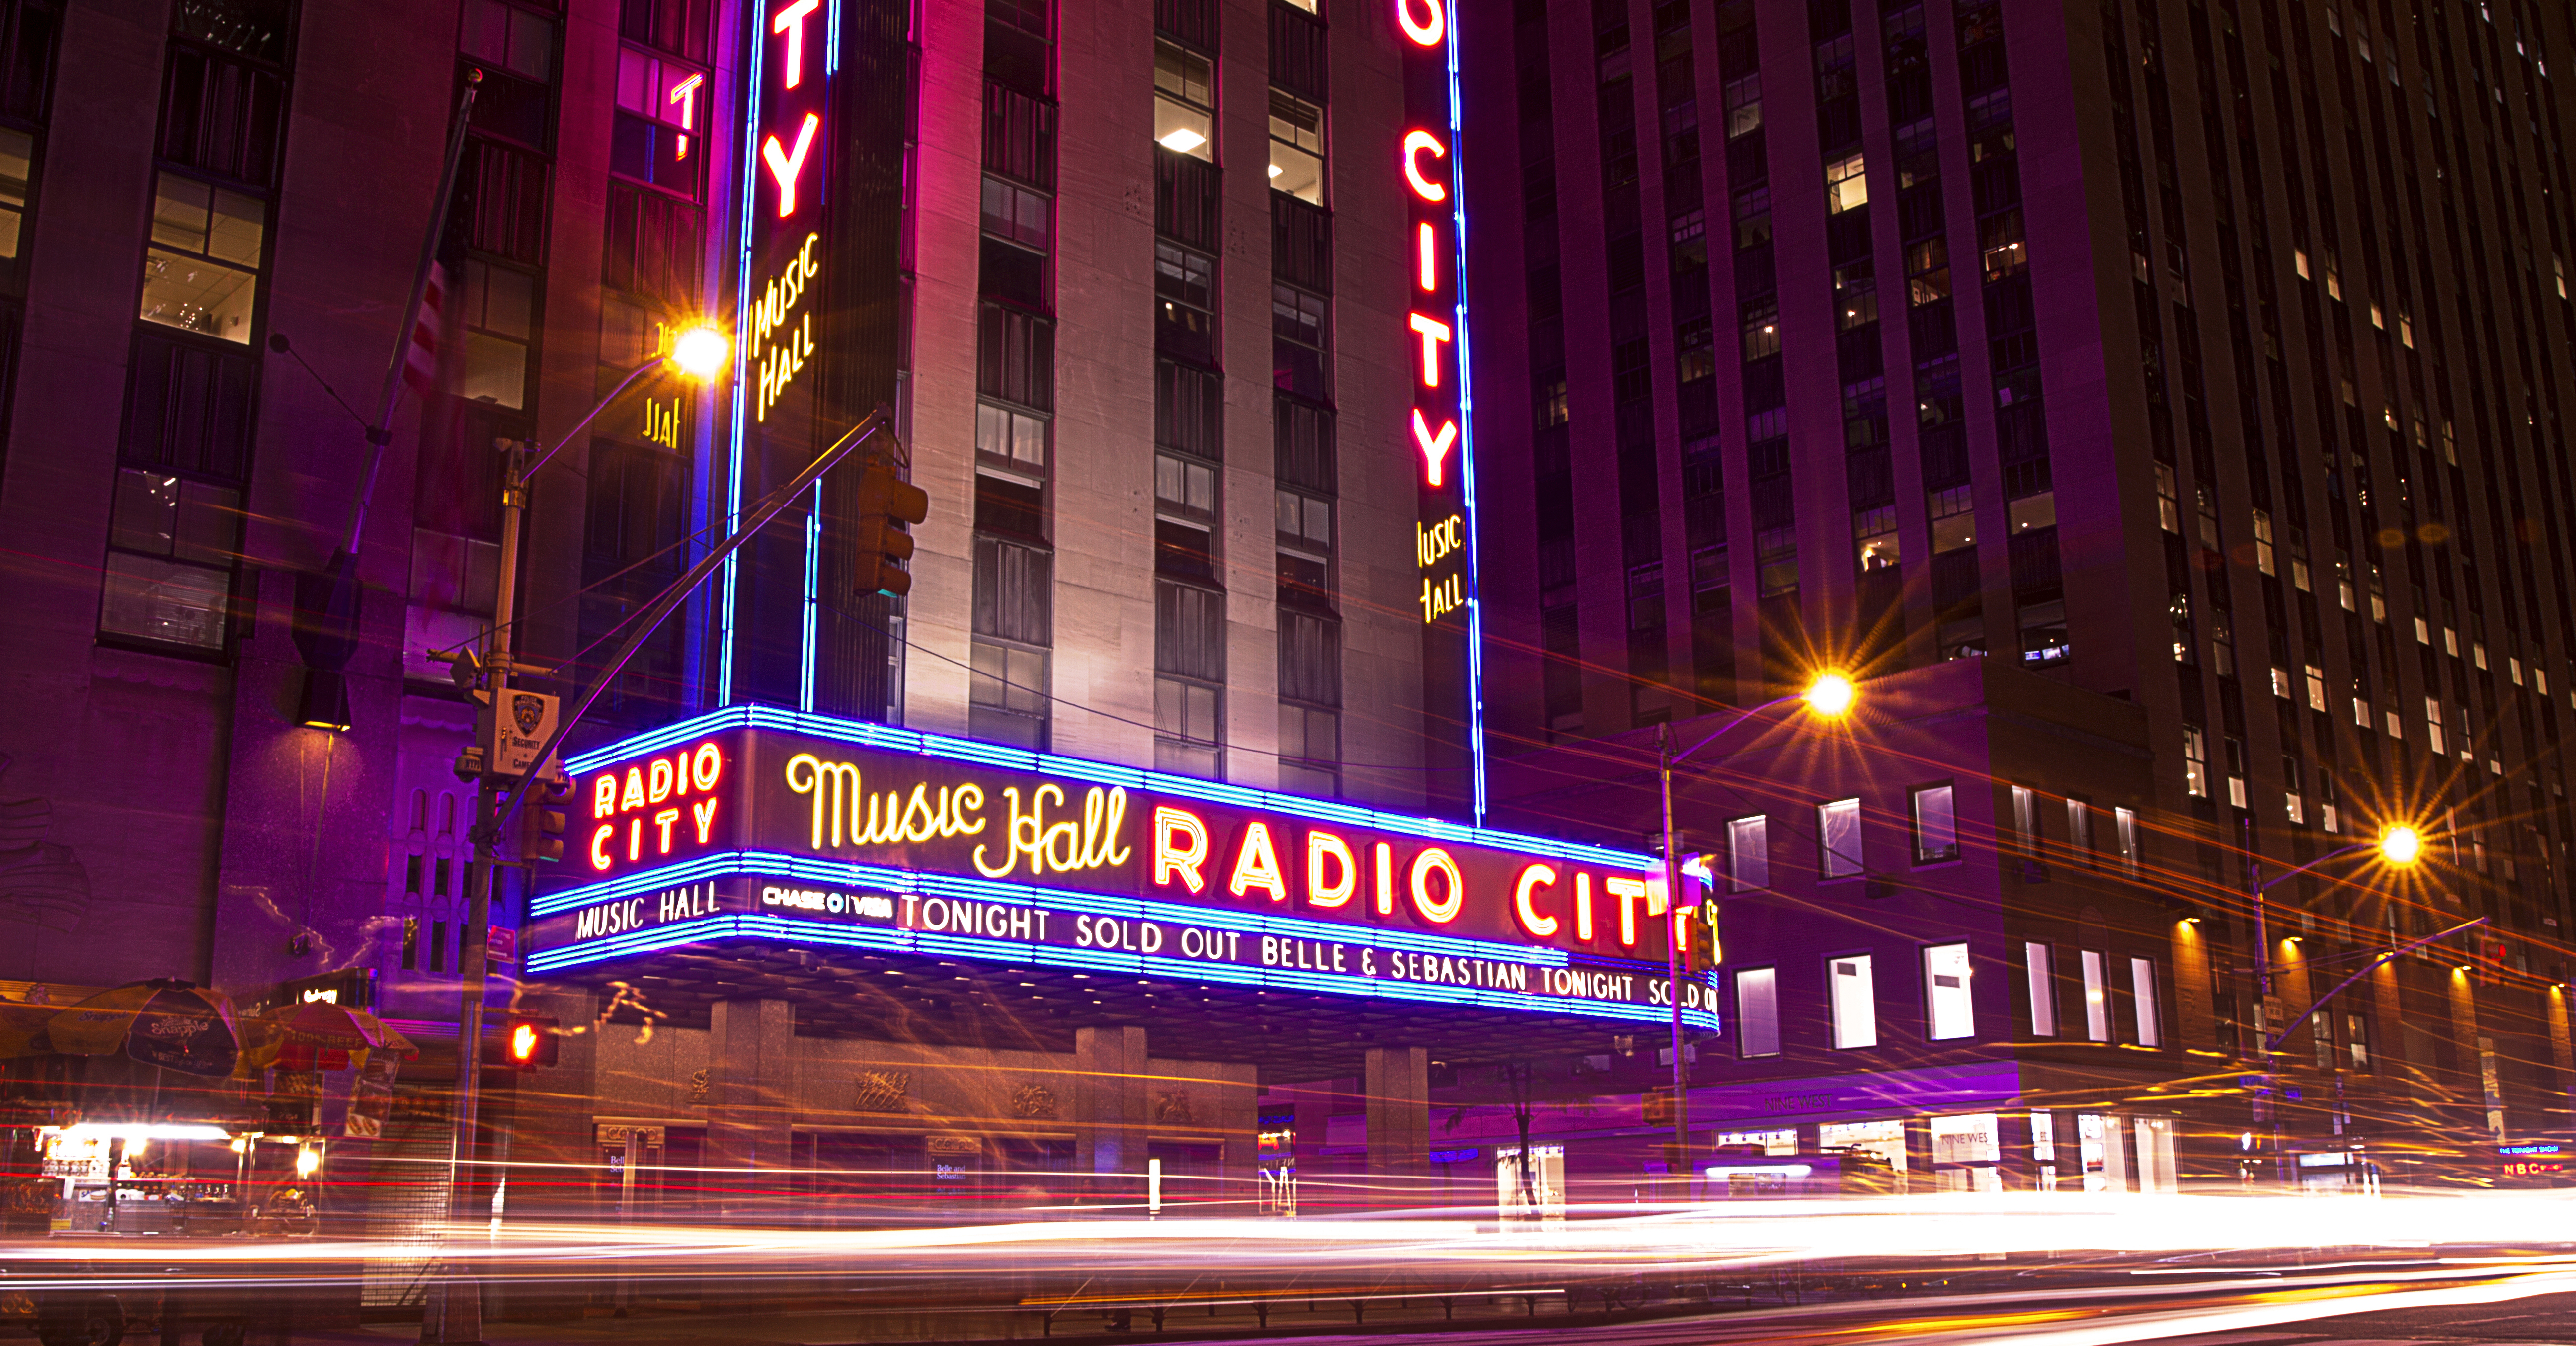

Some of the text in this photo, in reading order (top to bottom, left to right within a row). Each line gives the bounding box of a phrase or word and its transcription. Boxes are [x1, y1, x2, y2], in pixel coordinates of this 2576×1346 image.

[752, 231, 819, 359] MUSIC
[1404, 129, 1457, 487] CITY
[758, 311, 815, 422] HALL
[513, 758, 533, 770] CAME
[593, 742, 722, 820] RADIO
[590, 796, 719, 871] CITY
[786, 753, 987, 850] Music
[972, 784, 1131, 878] Hall
[1154, 804, 1464, 925] RADIO
[576, 880, 721, 941] MUSIC HALL
[762, 886, 826, 911] CHASE
[901, 894, 1051, 941] TONIGHT
[1076, 914, 1163, 953] SOLD
[1181, 927, 1241, 961] OUT
[1262, 935, 1347, 972] BELLE
[1361, 947, 1377, 975] &
[1391, 950, 1526, 990] SEBASTIAN
[1541, 966, 1633, 1001] TONIGHT
[151, 1019, 209, 1037] Snapple
[327, 1034, 363, 1048] BEEF
[1765, 1093, 1832, 1112] NINE WEST
[1940, 1132, 1988, 1145] NINE WES
[937, 1164, 952, 1173] Belle
[2503, 1162, 2540, 1175] NBC
